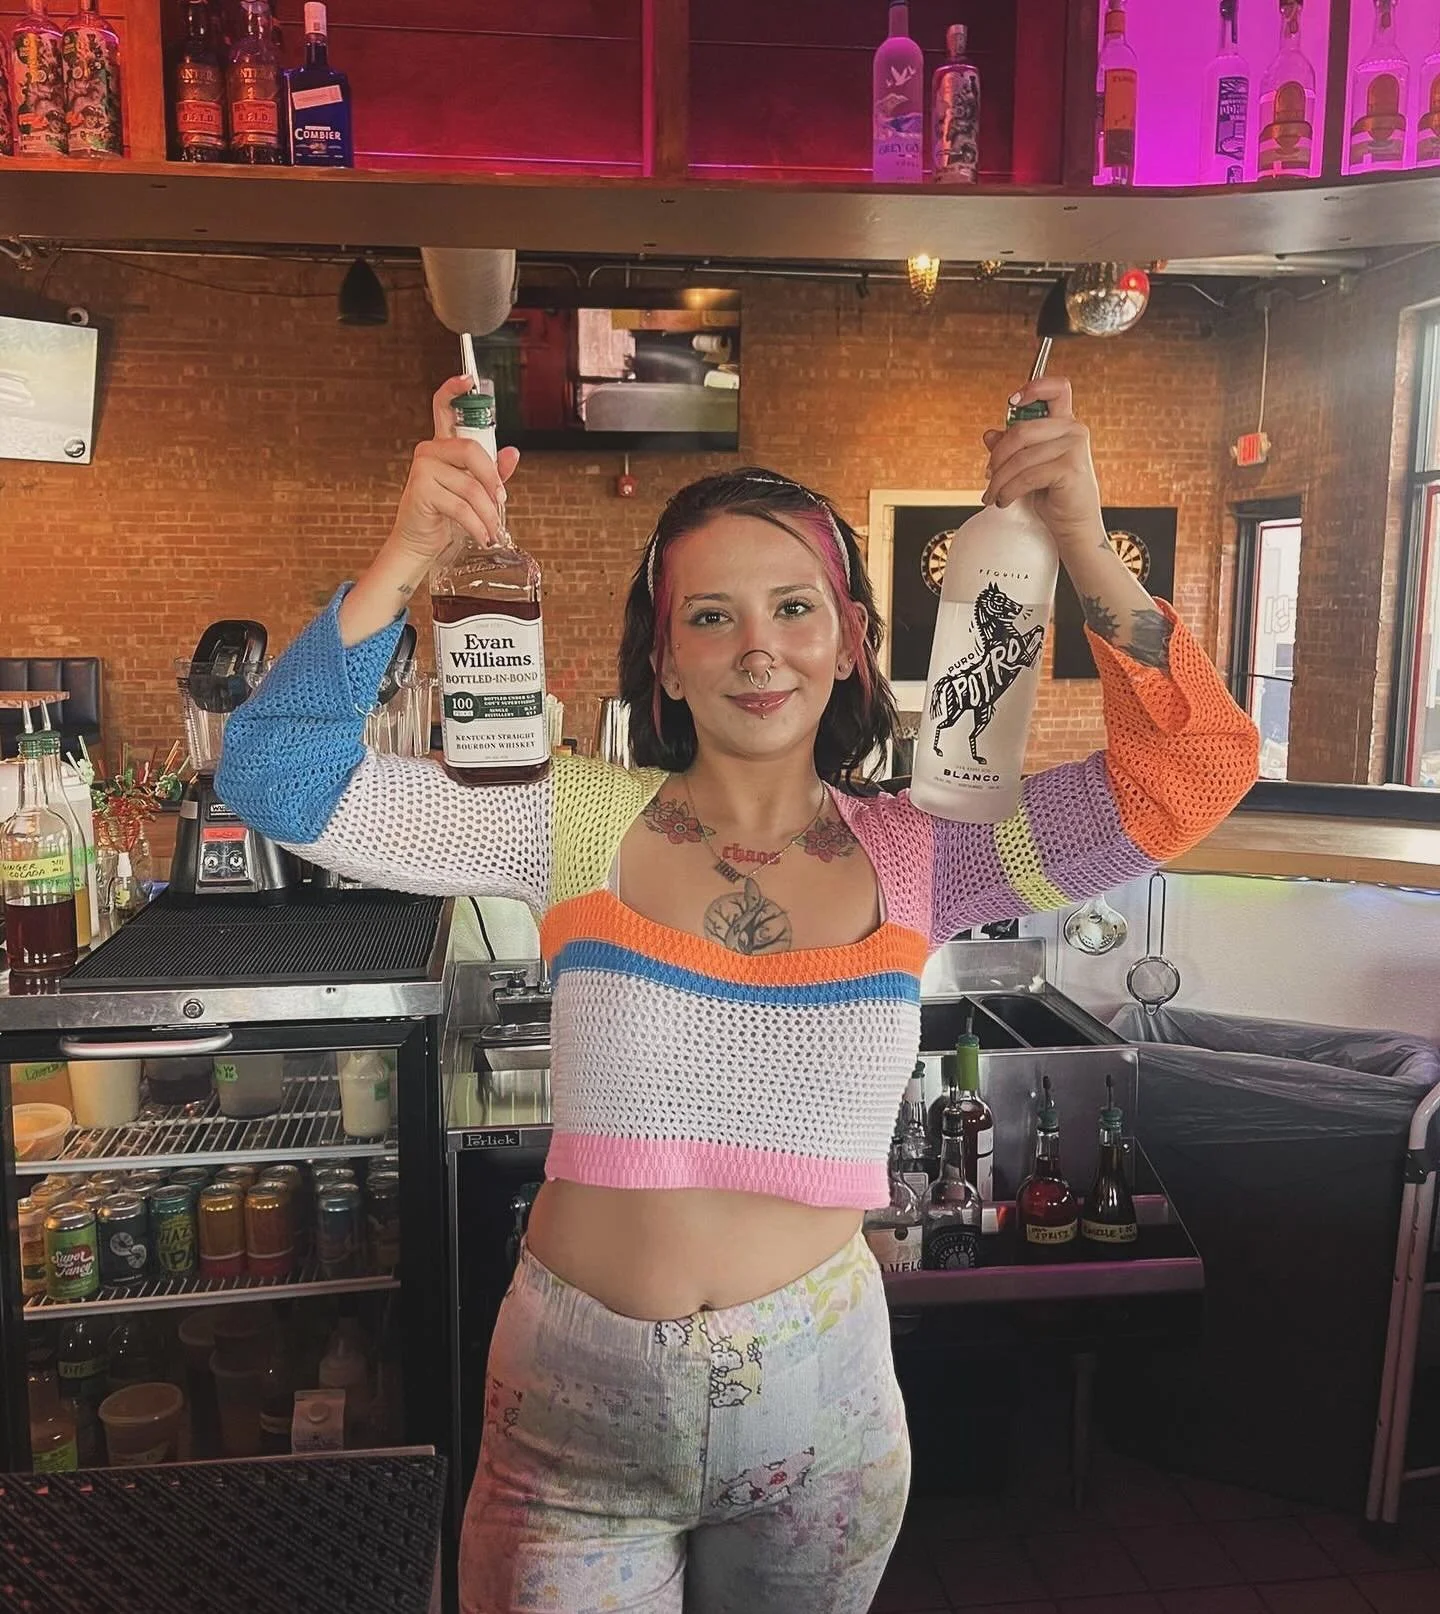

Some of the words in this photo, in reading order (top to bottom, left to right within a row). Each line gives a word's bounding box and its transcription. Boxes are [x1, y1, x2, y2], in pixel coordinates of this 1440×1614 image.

[294, 127, 342, 141] COMBIER
[979, 568, 1029, 580] TEQUILA
[463, 633, 516, 650] Evan
[449, 651, 533, 668] Williams
[947, 652, 975, 674] PURO
[445, 671, 538, 684] BOTTLED-IN-BOND
[951, 637, 1021, 710] POTRO
[452, 698, 474, 710] 100
[498, 732, 535, 740] STRAIGHT
[456, 742, 496, 750] BOURBON
[943, 768, 1000, 782] BLANCO
[466, 1134, 517, 1147] Perlick
